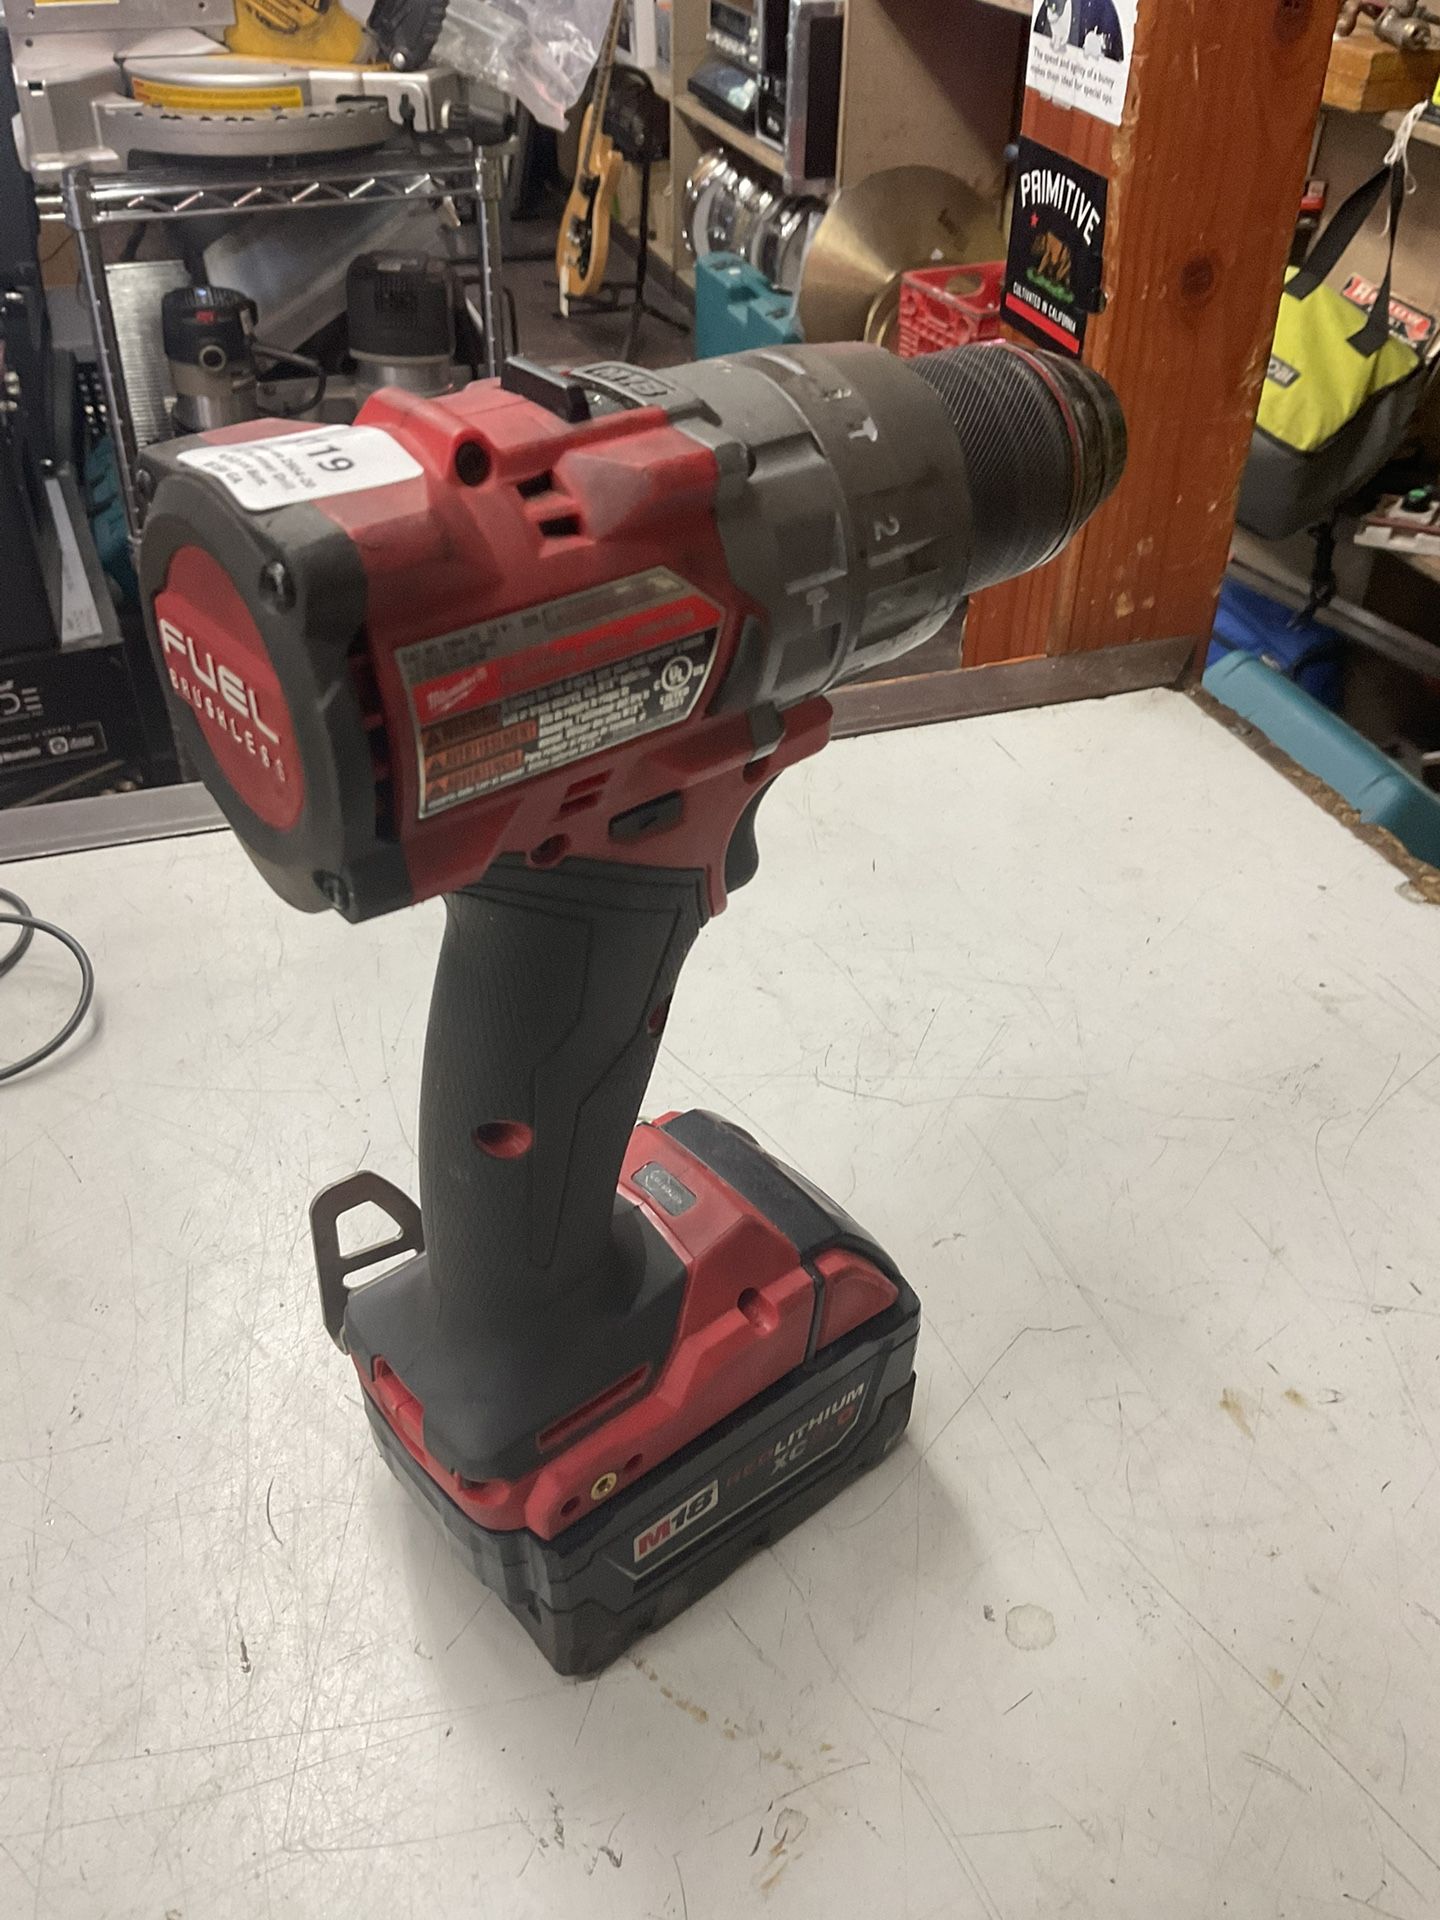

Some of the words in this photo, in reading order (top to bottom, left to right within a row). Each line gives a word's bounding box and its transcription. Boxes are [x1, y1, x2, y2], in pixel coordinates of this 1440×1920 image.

[1020, 169, 1100, 246] PRIMITIVE
[1012, 281, 1041, 310] CULTIVATED
[1041, 300, 1048, 315] IN
[1048, 304, 1077, 334] CALIFORNIA
[874, 515, 900, 541] 2
[159, 618, 280, 744] FUEL
[168, 667, 286, 783] BRUSHLESS
[770, 1440, 808, 1477] XC
[637, 1489, 714, 1556] M18
